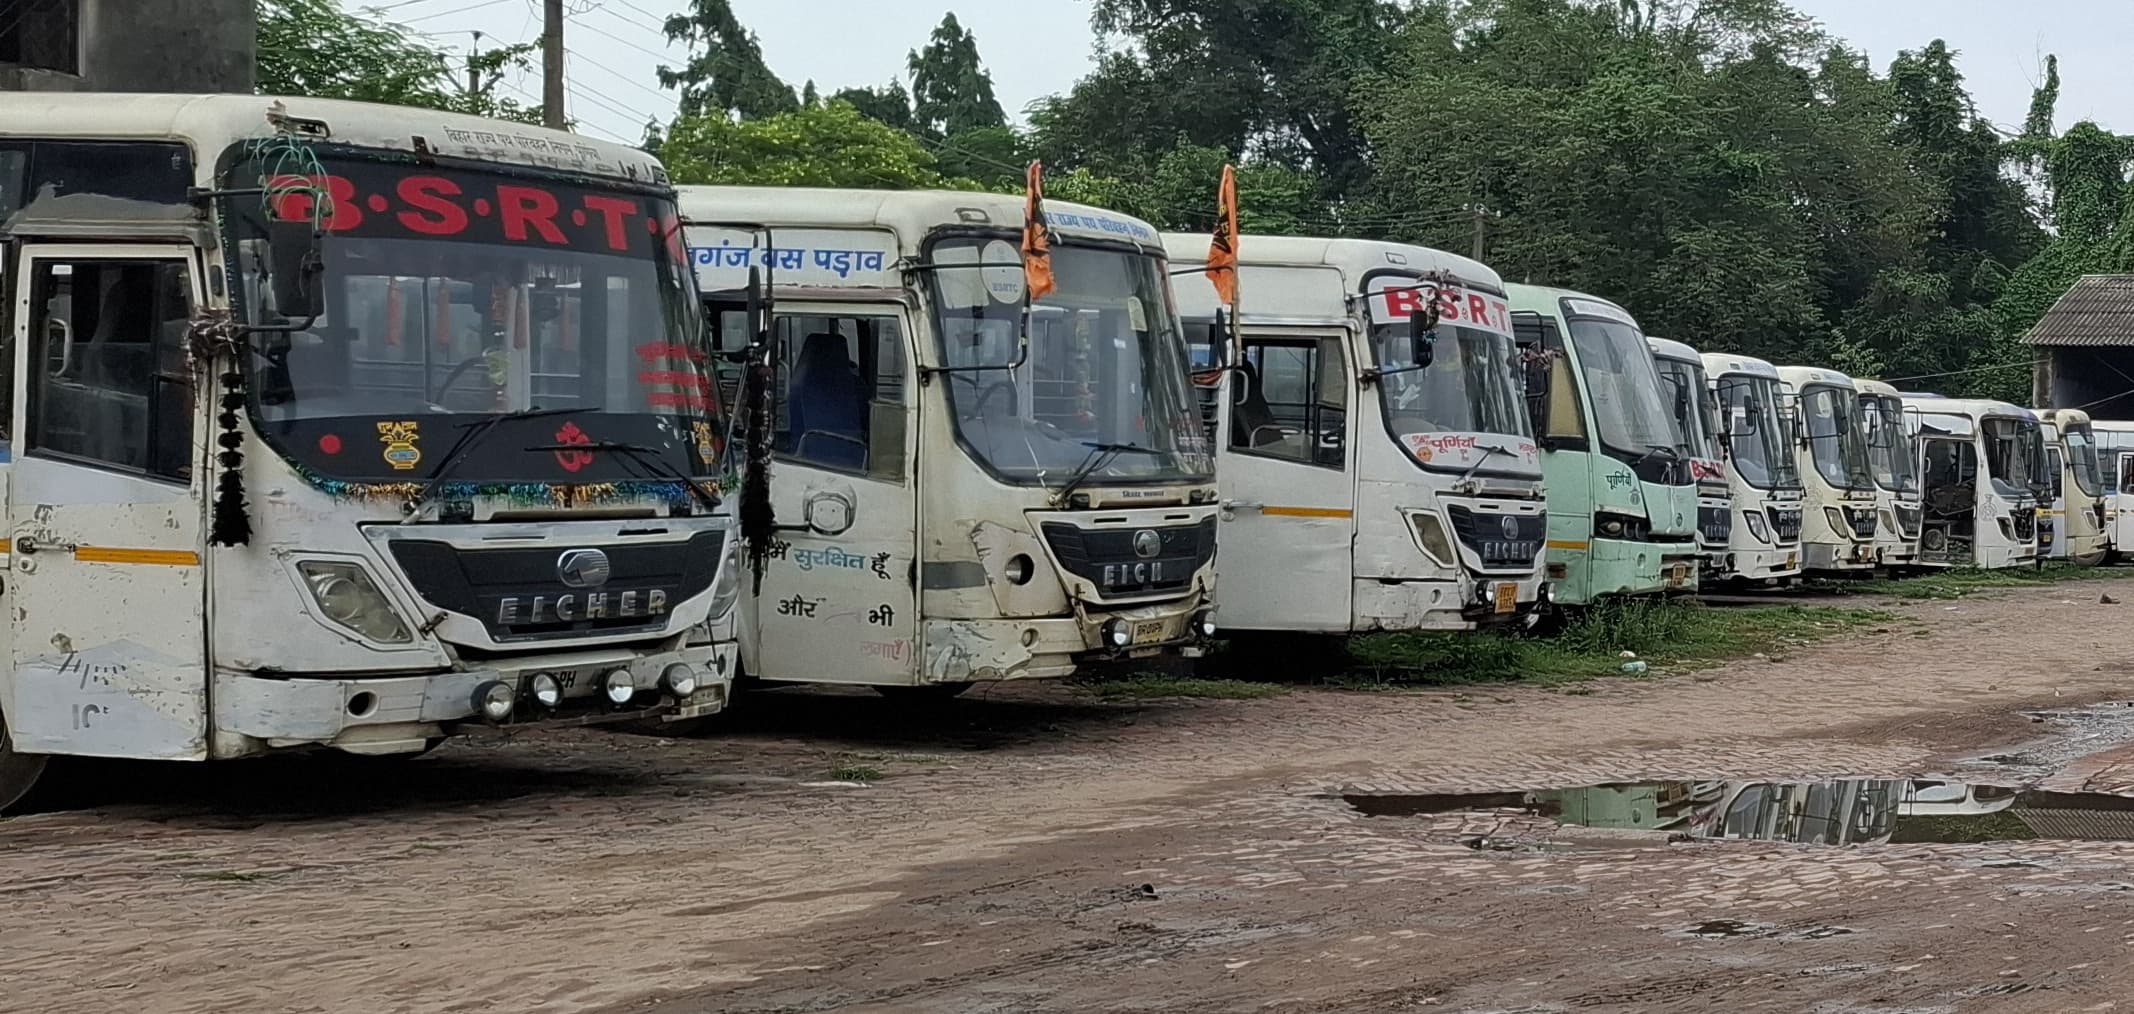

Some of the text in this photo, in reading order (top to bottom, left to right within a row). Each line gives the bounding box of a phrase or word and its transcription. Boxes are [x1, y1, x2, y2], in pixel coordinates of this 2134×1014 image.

[444, 126, 472, 145] बिहार
[814, 249, 885, 278] पड़ाव
[794, 545, 866, 572] सुरक्षित
[870, 551, 892, 580] हूँ
[498, 588, 667, 625] EICHER
[776, 593, 895, 628] और भी
